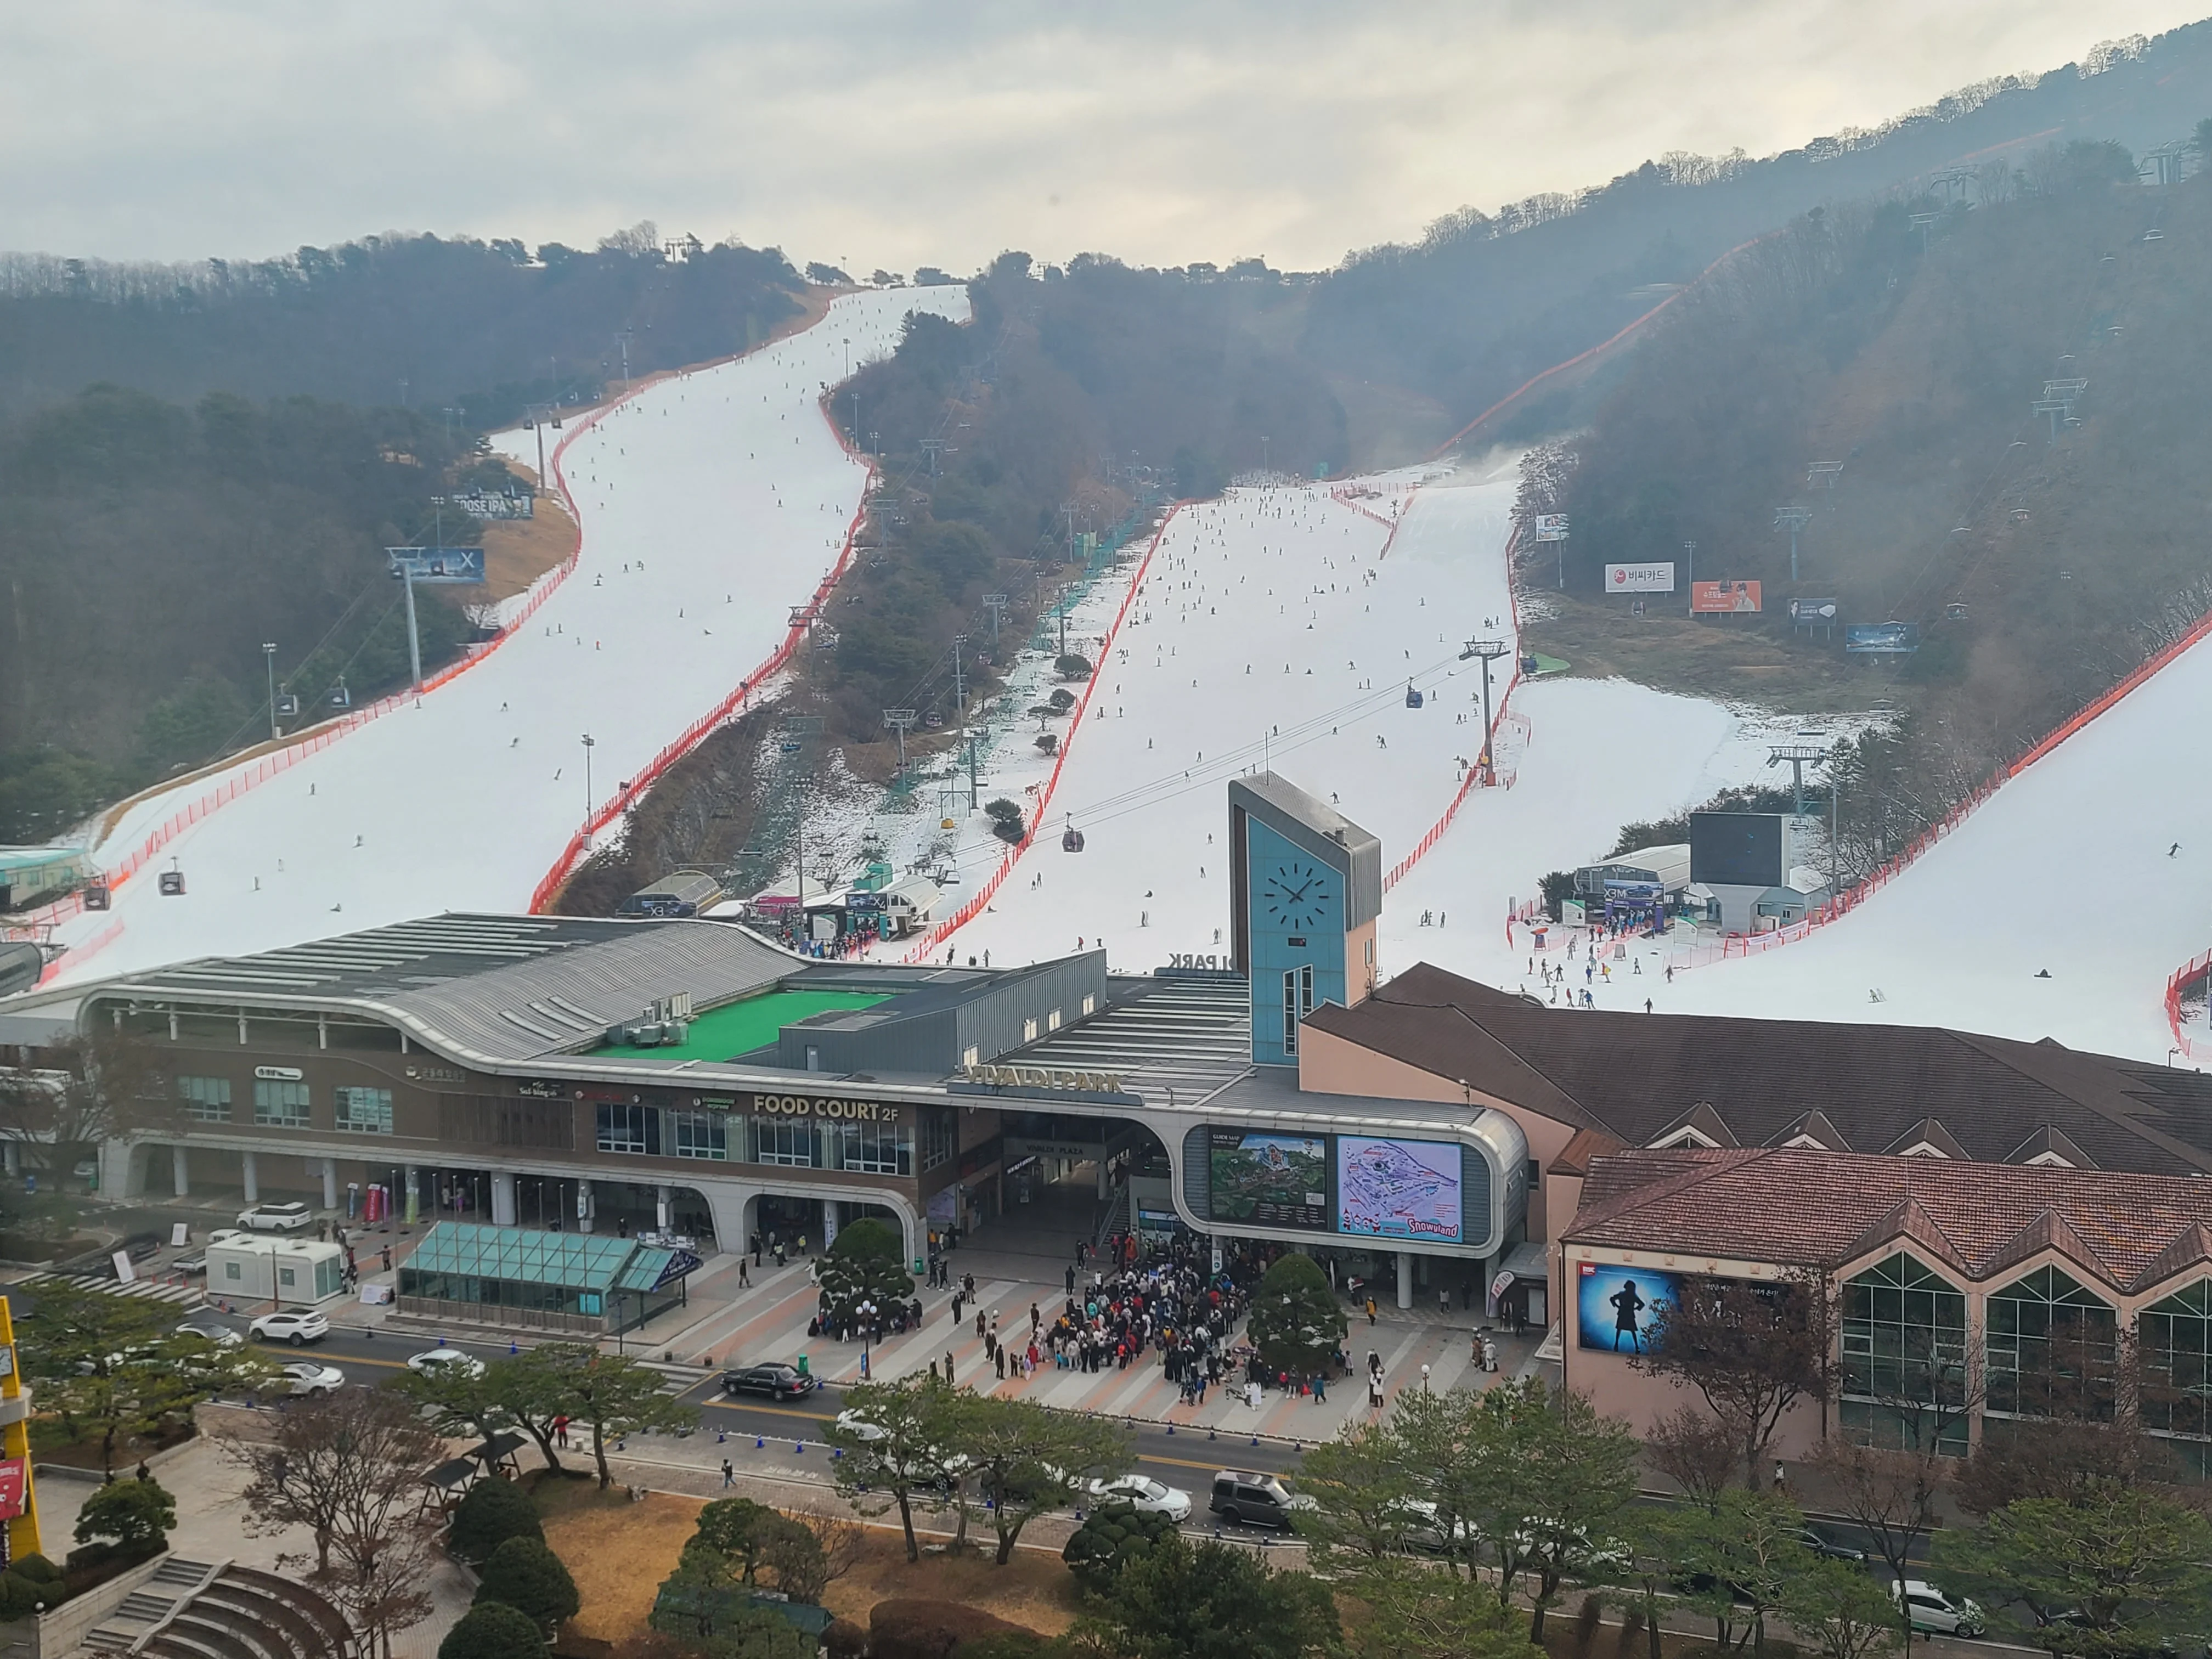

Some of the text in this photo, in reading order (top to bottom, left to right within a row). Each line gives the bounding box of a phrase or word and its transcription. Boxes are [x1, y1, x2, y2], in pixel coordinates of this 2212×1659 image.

[489, 500, 506, 512] IPA
[461, 552, 475, 568] X
[1628, 569, 1666, 582] 비씨카드
[1604, 888, 1627, 899] X3M
[873, 897, 886, 910] X4
[650, 907, 664, 916] X3
[965, 1065, 1125, 1093] VIVALDI PARK
[754, 1095, 899, 1121] FOOD COURT 2F
[1026, 1145, 1054, 1153] VIVALDI
[1408, 1219, 1458, 1237] Snowyland
